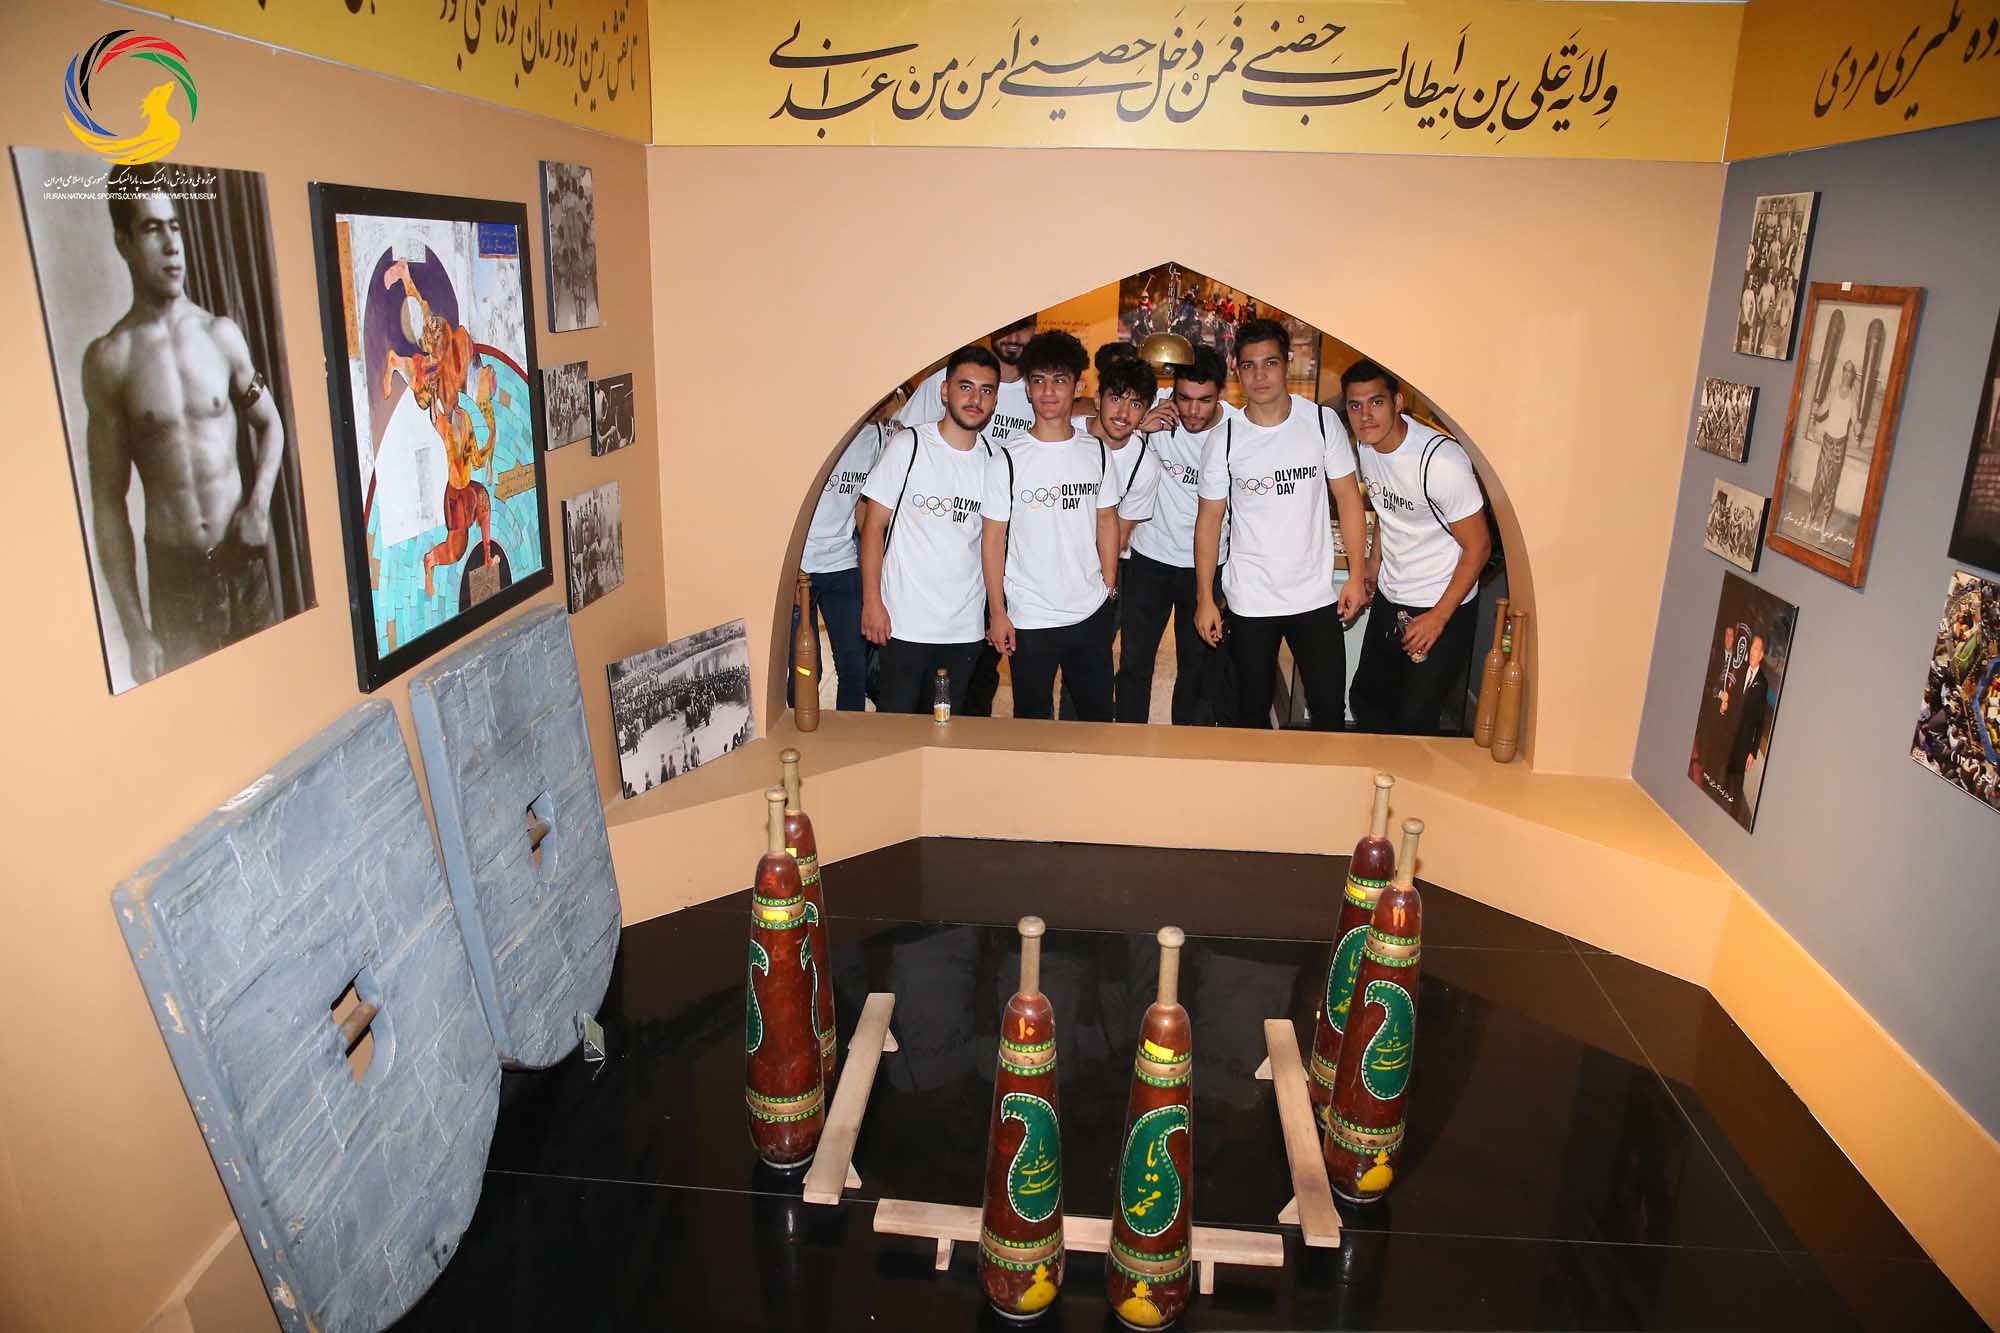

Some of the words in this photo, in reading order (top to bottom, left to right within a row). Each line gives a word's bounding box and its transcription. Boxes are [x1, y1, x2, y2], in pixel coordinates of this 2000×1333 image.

[994, 414, 1032, 431] OLYMPIC
[992, 426, 1010, 440] DAY
[841, 471, 868, 483] OLYMP
[1274, 465, 1318, 482] OLYMPIC
[839, 483, 856, 495] DAY
[1062, 482, 1100, 496] OLYMPIC
[1276, 482, 1296, 496] DAY
[953, 496, 982, 513] OLYM
[1062, 497, 1080, 510] DAY
[1383, 485, 1415, 511] OYMPIC
[952, 510, 969, 523] DAY
